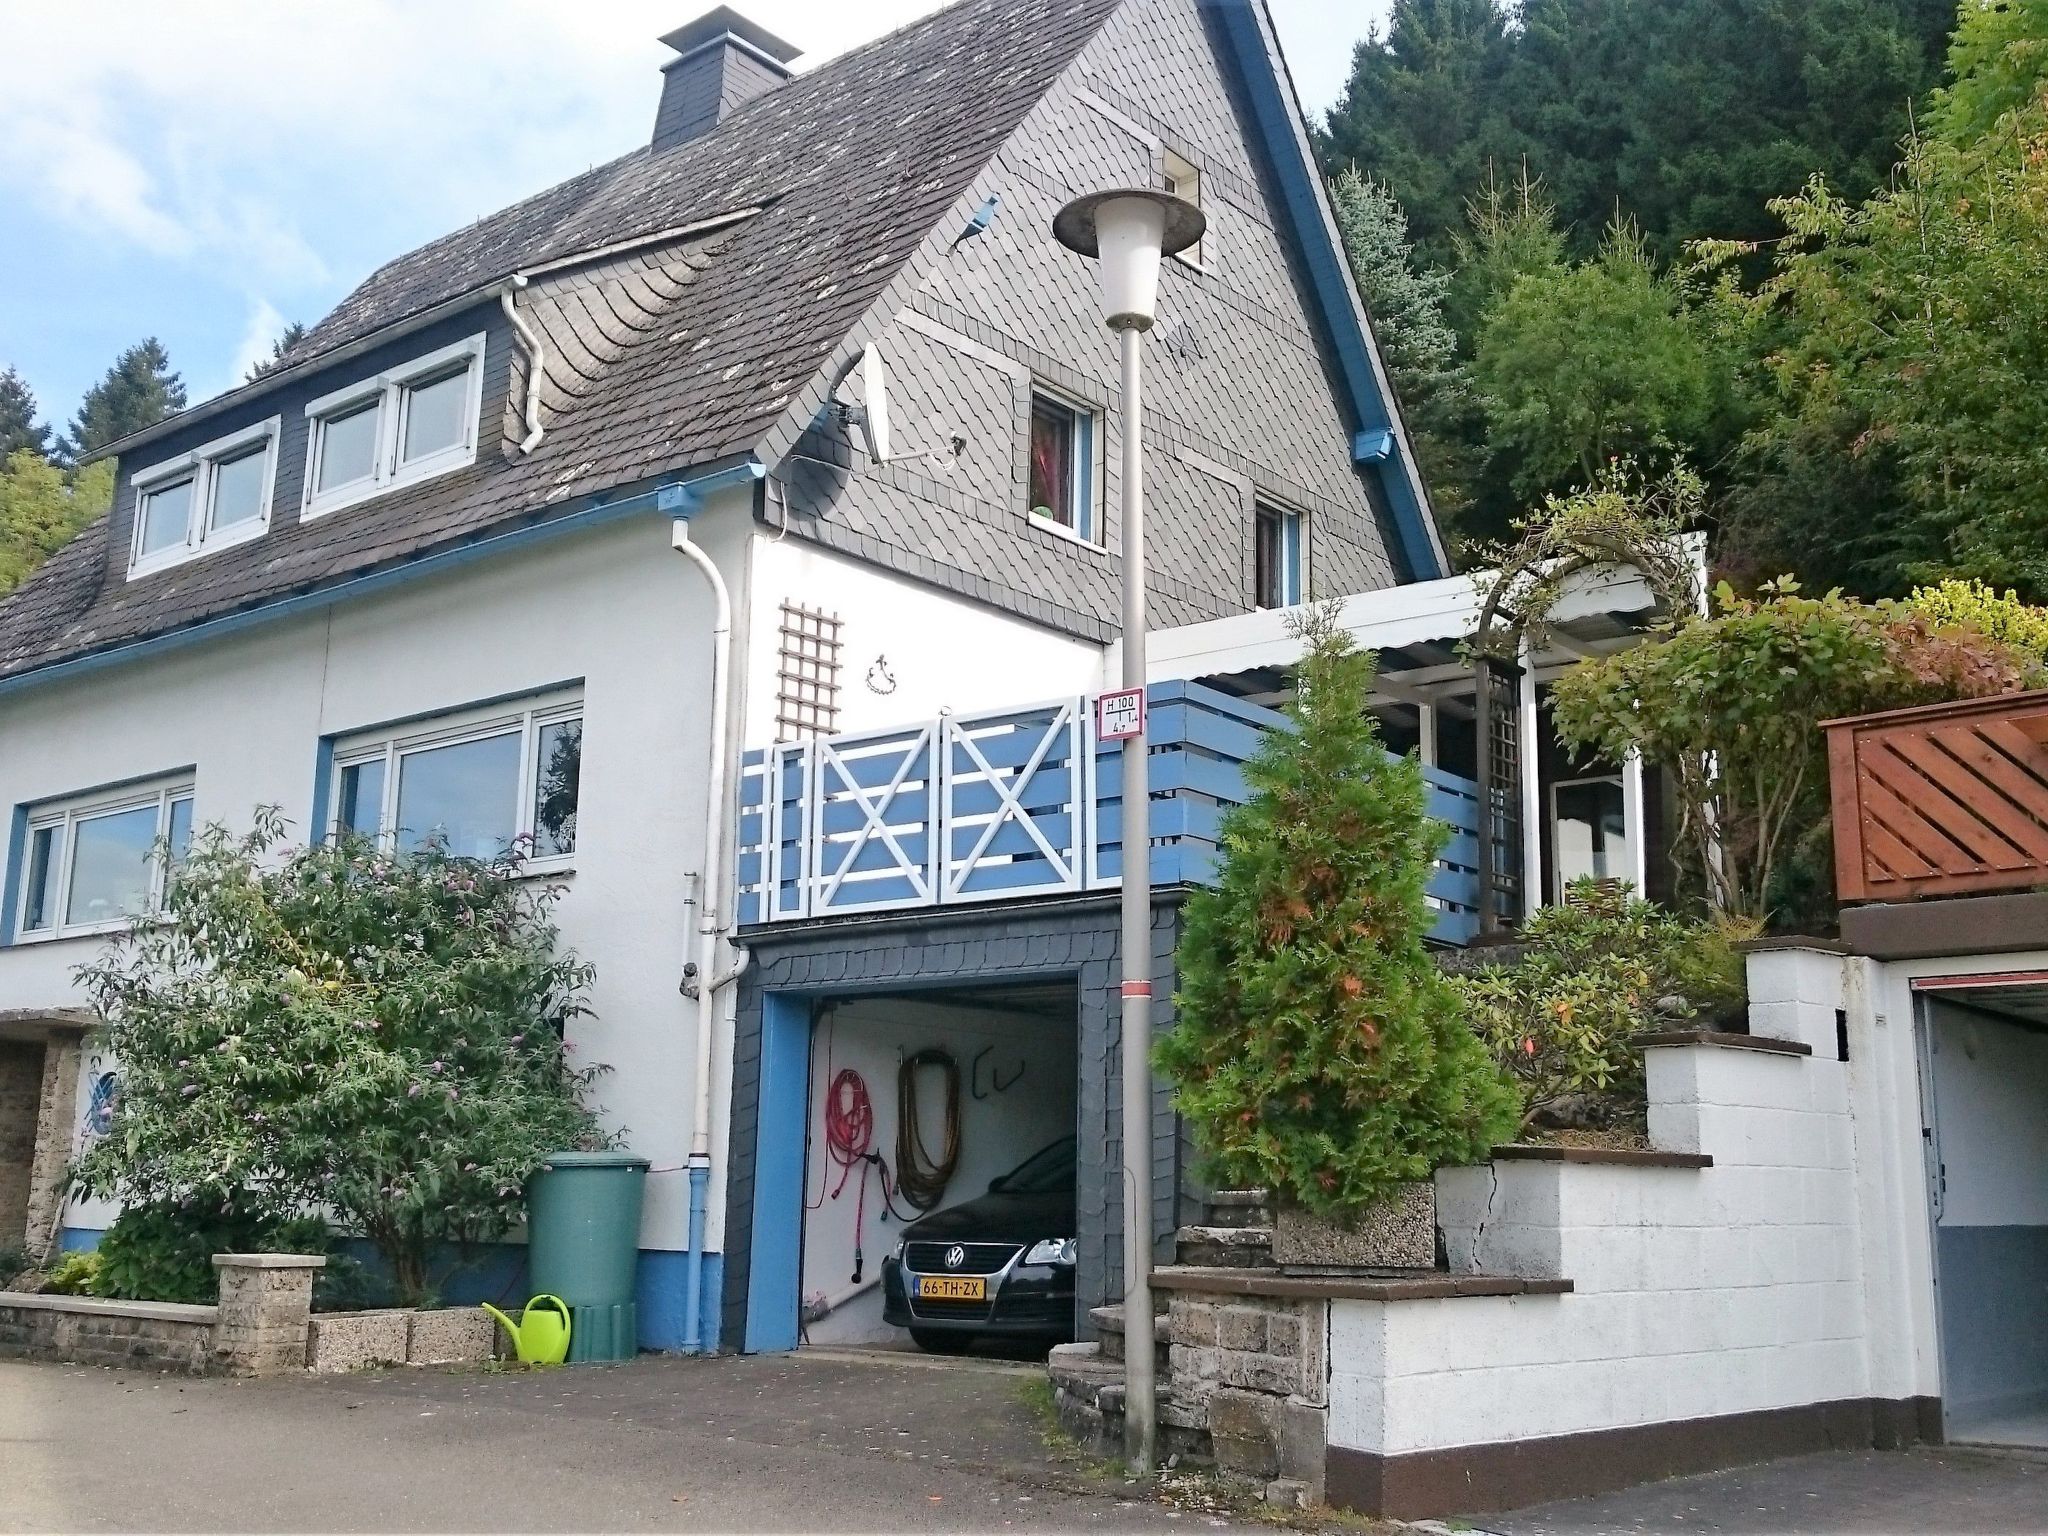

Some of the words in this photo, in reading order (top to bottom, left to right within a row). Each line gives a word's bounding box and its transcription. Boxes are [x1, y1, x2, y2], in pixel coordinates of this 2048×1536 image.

[1107, 700, 1114, 711] H
[1118, 696, 1134, 709] 100
[923, 1281, 979, 1296] 66-TH-ZX
